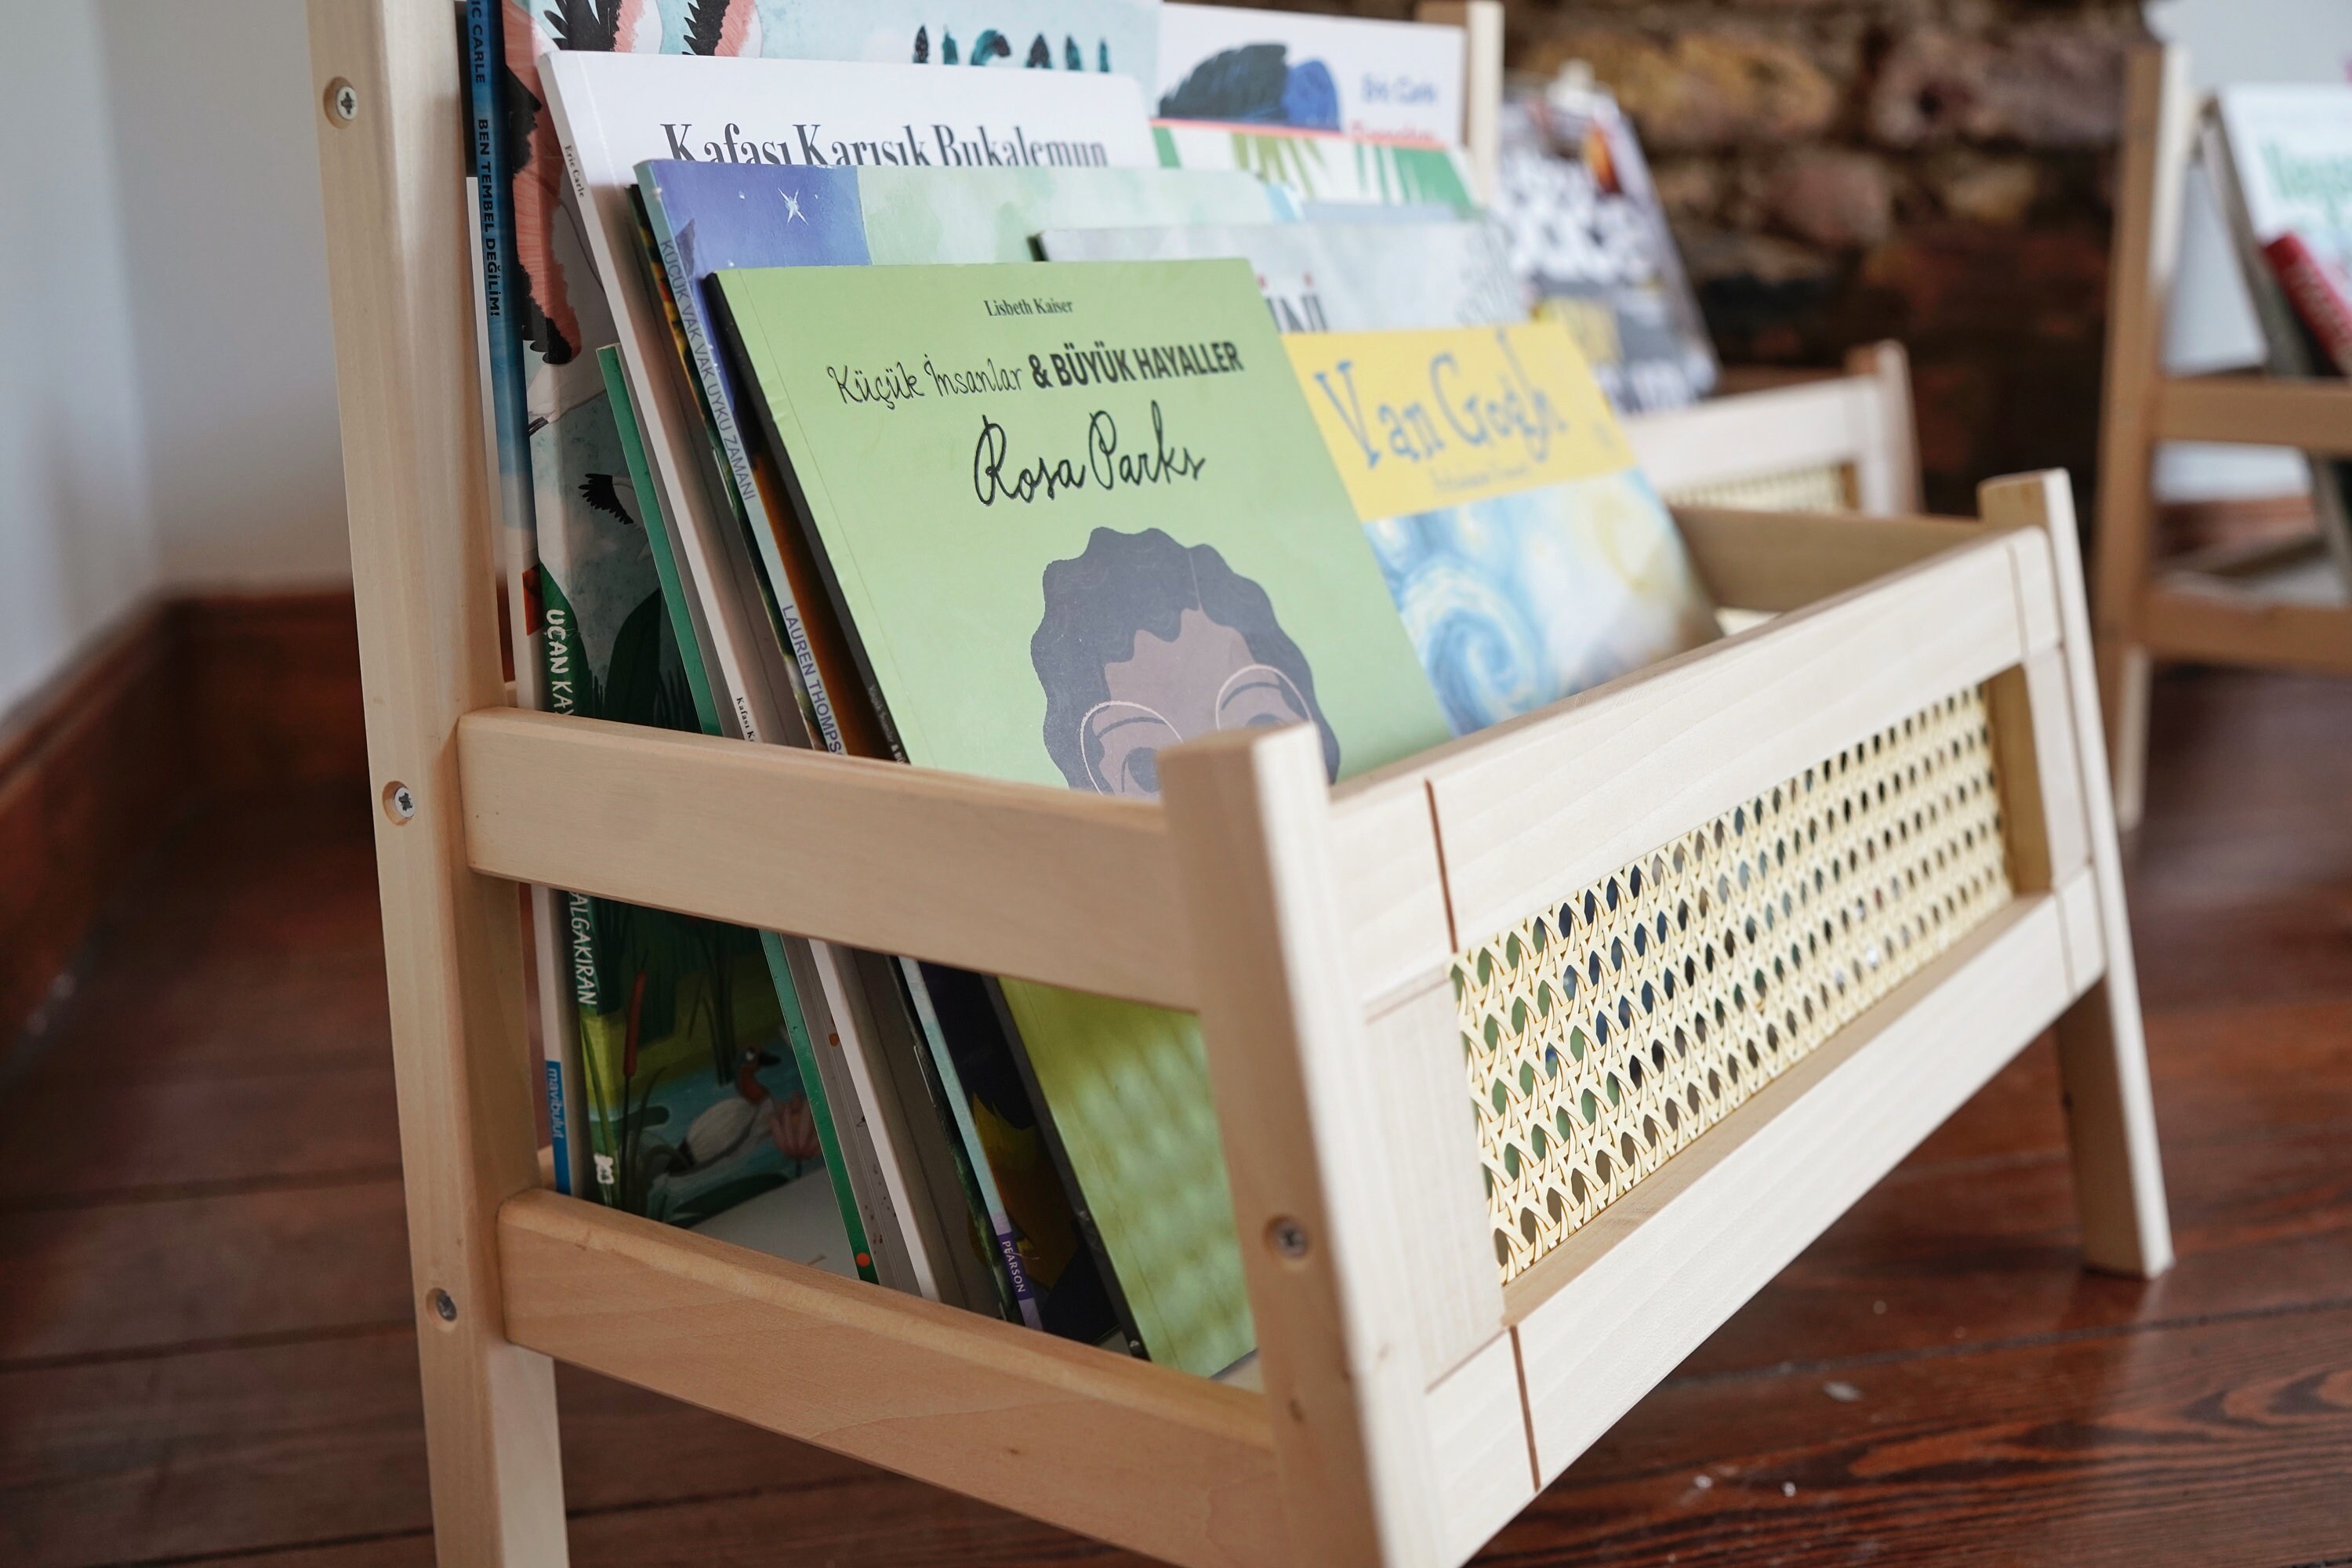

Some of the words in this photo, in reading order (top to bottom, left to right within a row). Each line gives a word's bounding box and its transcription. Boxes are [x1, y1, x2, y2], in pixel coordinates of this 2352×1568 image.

[470, 0, 481, 18] IC
[472, 24, 485, 84] CARLE
[478, 119, 490, 155] BEN
[564, 145, 575, 168] Eric
[573, 169, 585, 198] Carle
[481, 162, 495, 233] TEMBEL
[485, 238, 501, 317] DEĞİLİM!
[983, 298, 1033, 317] Lisbeth
[1033, 297, 1073, 314] Kaiser
[681, 303, 702, 342] VAK
[695, 344, 716, 381] VAK
[707, 383, 733, 432] UYKU
[723, 434, 756, 501] ZAMANI
[827, 361, 924, 410] Küçük
[924, 354, 1022, 397] İnsanlar
[1028, 354, 1054, 389] &
[1050, 340, 1137, 387] BÜYÜK
[1131, 340, 1245, 380] HAYALLER
[1314, 359, 1444, 470] Van
[1428, 327, 1569, 463] Gogh
[974, 415, 1086, 507] Rosa
[1089, 400, 1206, 491] Parks
[736, 696, 750, 729] Kafası
[782, 604, 816, 677] LAUREN
[809, 679, 844, 755] THOMPS
[569, 891, 598, 1005] ALGAKIRAN
[1002, 1240, 1026, 1293] PEARSON
